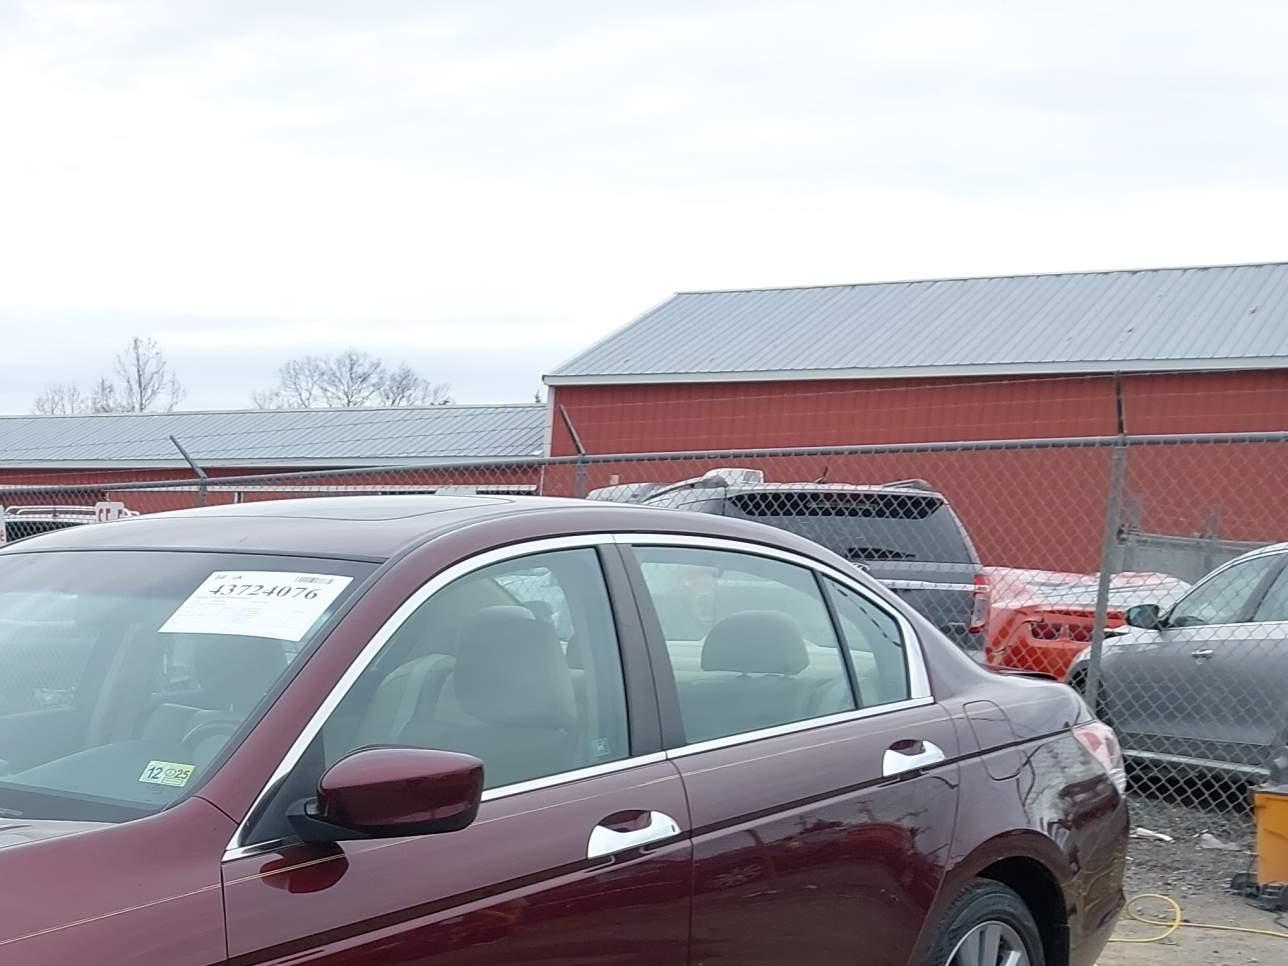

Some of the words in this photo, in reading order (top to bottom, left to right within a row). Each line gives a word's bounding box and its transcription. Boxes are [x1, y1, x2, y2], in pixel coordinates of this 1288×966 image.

[208, 583, 321, 600] 43724076
[147, 766, 163, 779] 12
[174, 769, 191, 780] 25
